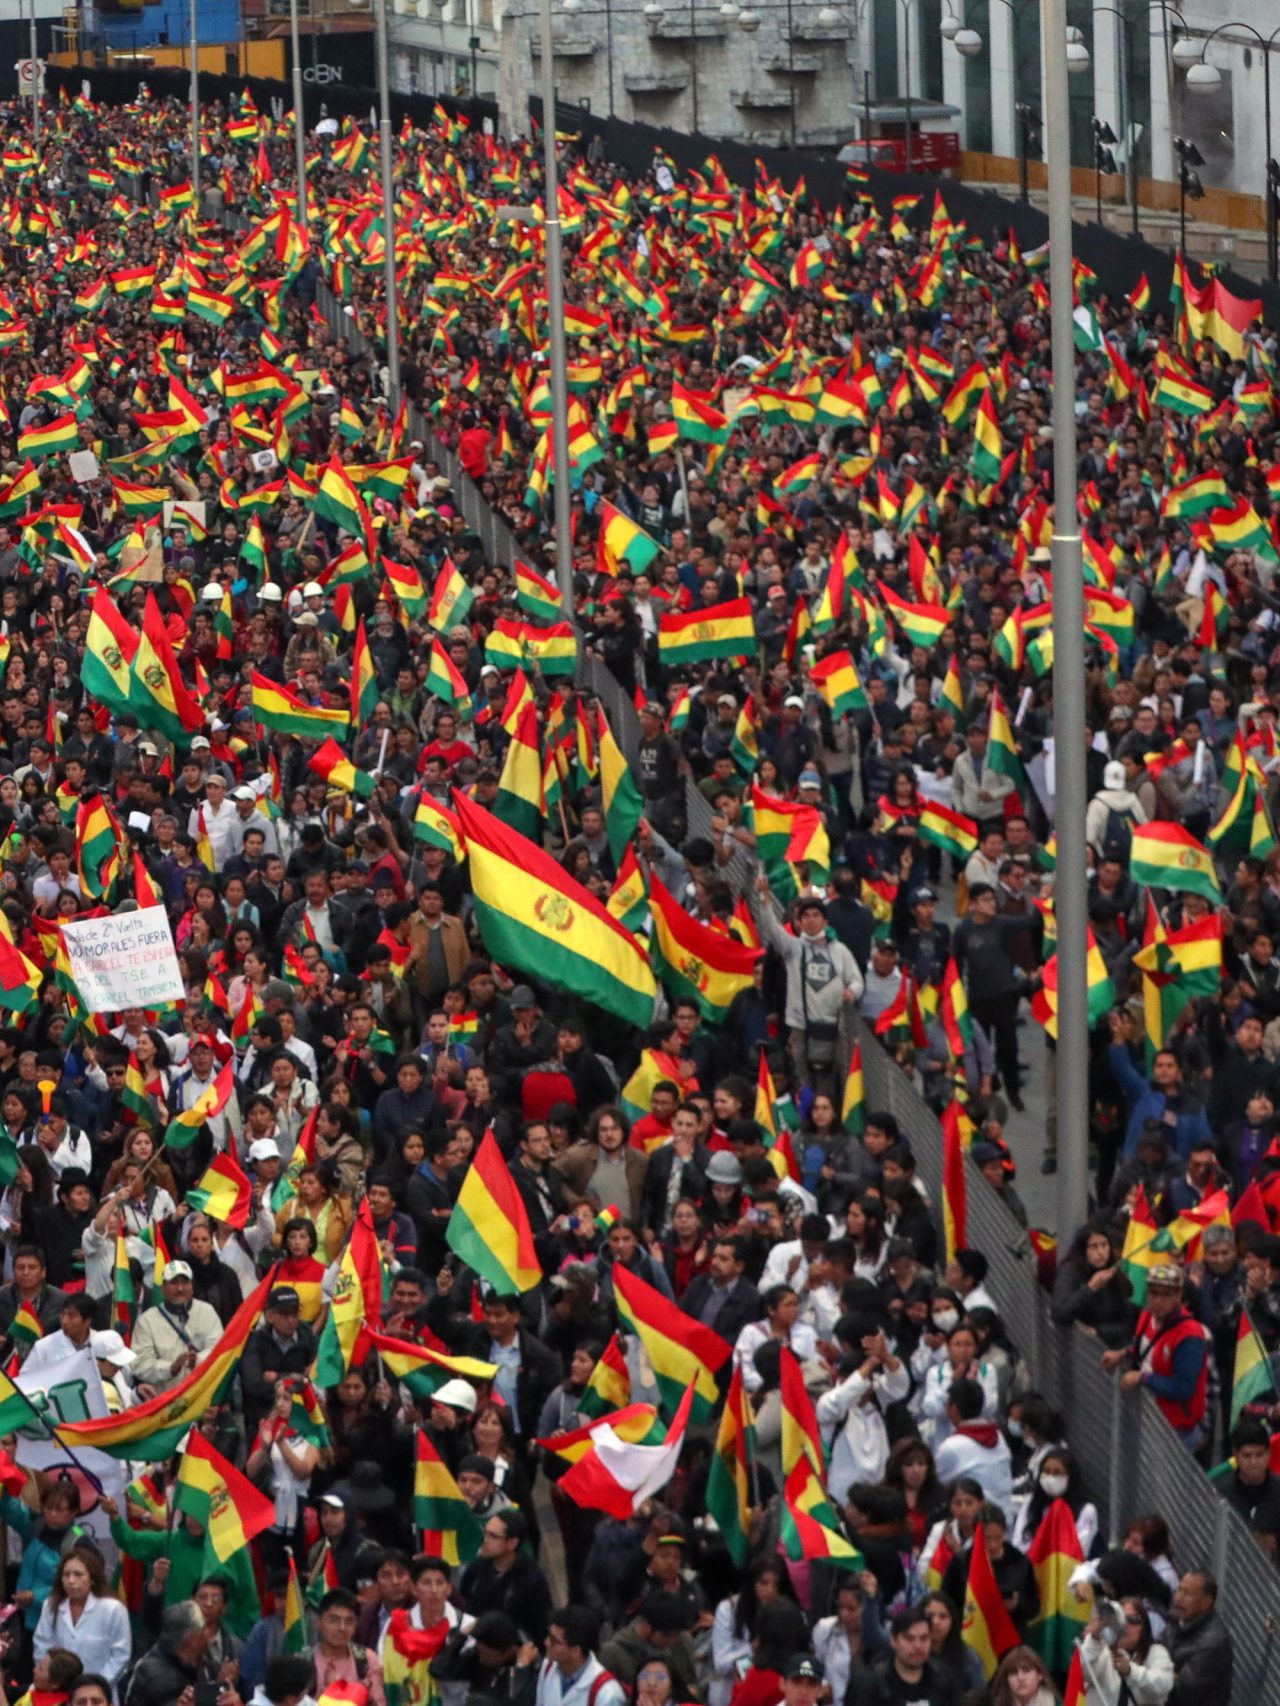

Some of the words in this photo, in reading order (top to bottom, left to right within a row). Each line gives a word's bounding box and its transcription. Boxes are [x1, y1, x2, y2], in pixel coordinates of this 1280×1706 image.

[304, 64, 342, 83] CBN
[85, 936, 136, 957] MORALES
[138, 930, 168, 947] FUERA
[128, 954, 141, 966] TE
[121, 969, 148, 982] TSE
[158, 964, 166, 975] A
